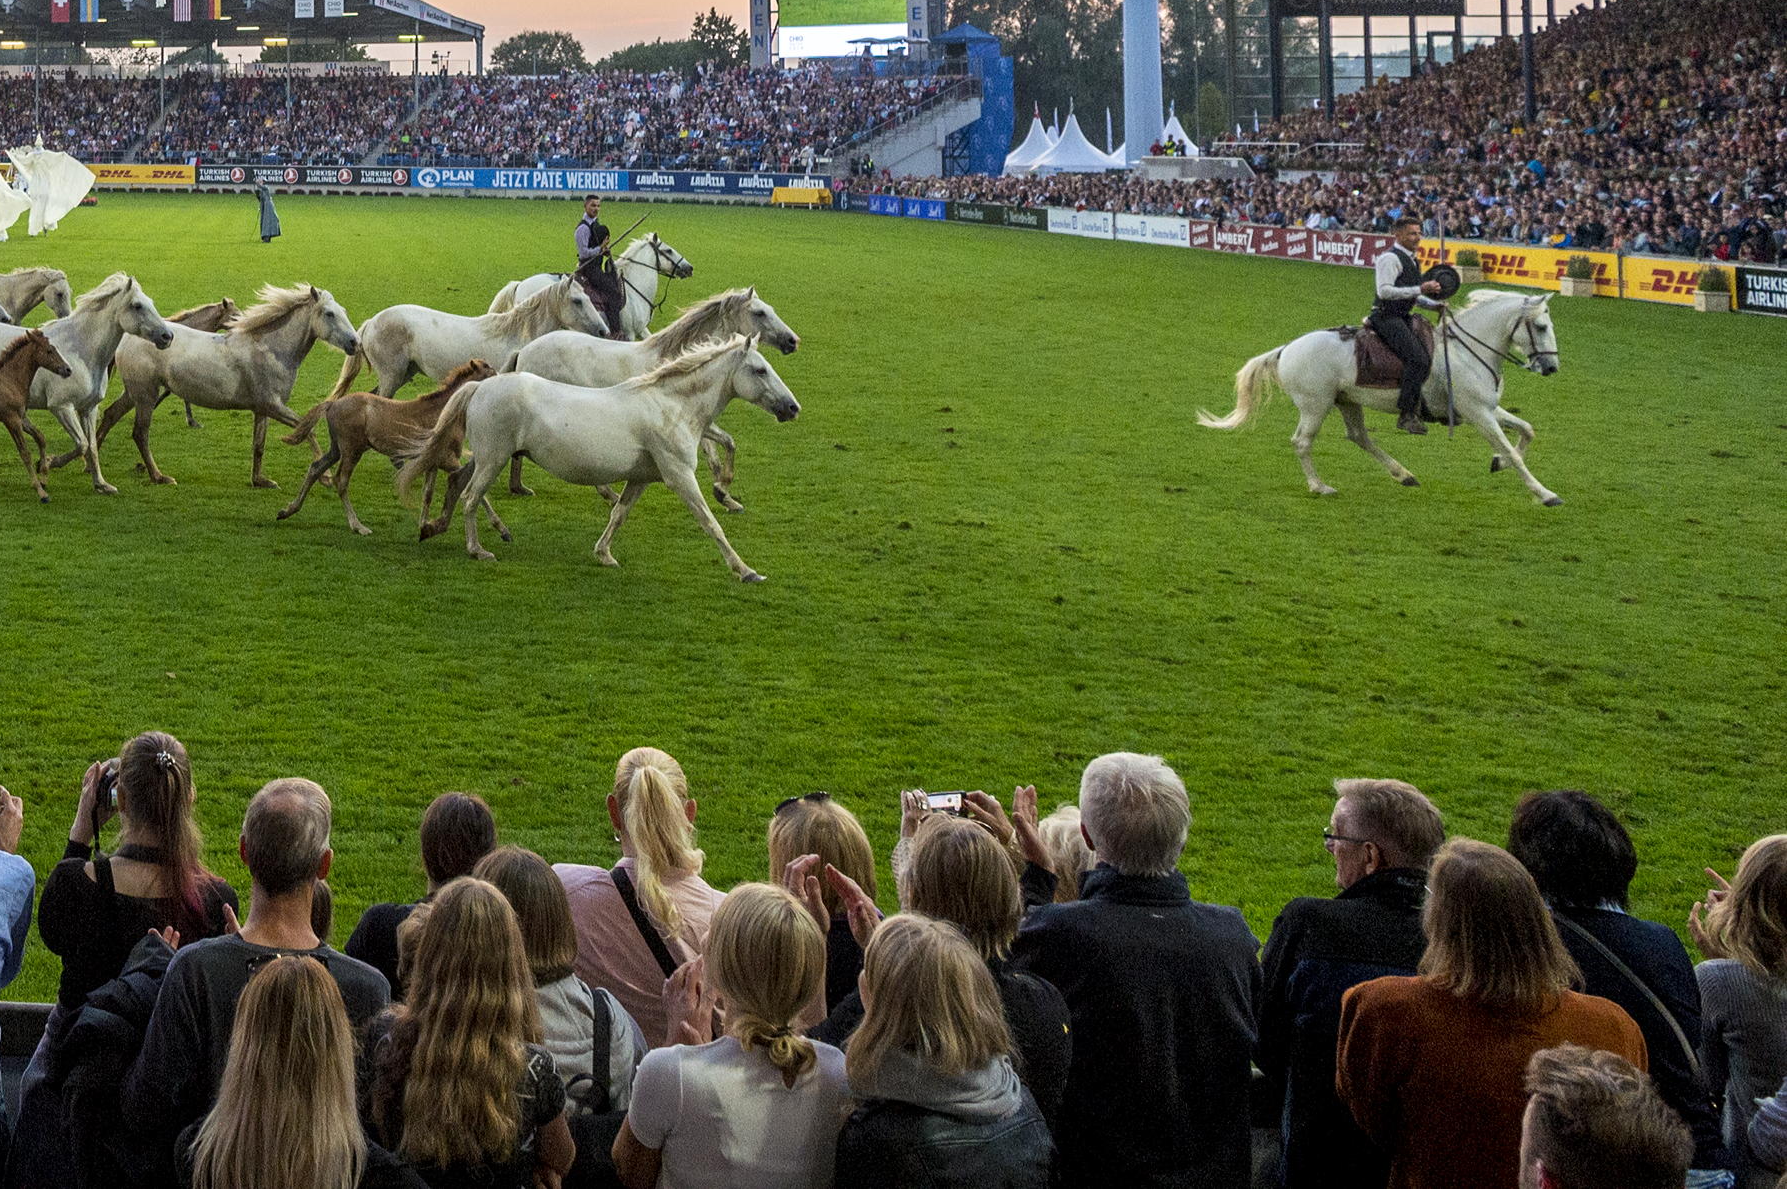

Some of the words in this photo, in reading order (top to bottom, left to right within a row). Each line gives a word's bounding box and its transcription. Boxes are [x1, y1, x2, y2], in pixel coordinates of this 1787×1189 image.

[99, 170, 133, 178] DHL
[152, 170, 186, 179] DHL
[442, 170, 474, 181] PLAN
[492, 170, 529, 188] JETZT
[533, 171, 563, 188] PATE
[566, 171, 619, 189] WERDEN!
[636, 171, 675, 185] LAVAZZA
[690, 173, 725, 187] LAVAZZA
[738, 174, 774, 188] LAVAZZA
[788, 175, 825, 188] LAVAZZA
[1213, 225, 1255, 253] LAMBERTZ
[1313, 234, 1365, 265] LAMBERTZ
[1481, 252, 1530, 277] DHL
[1652, 269, 1698, 295] DH
[1747, 292, 1787, 309] AIRLIN
